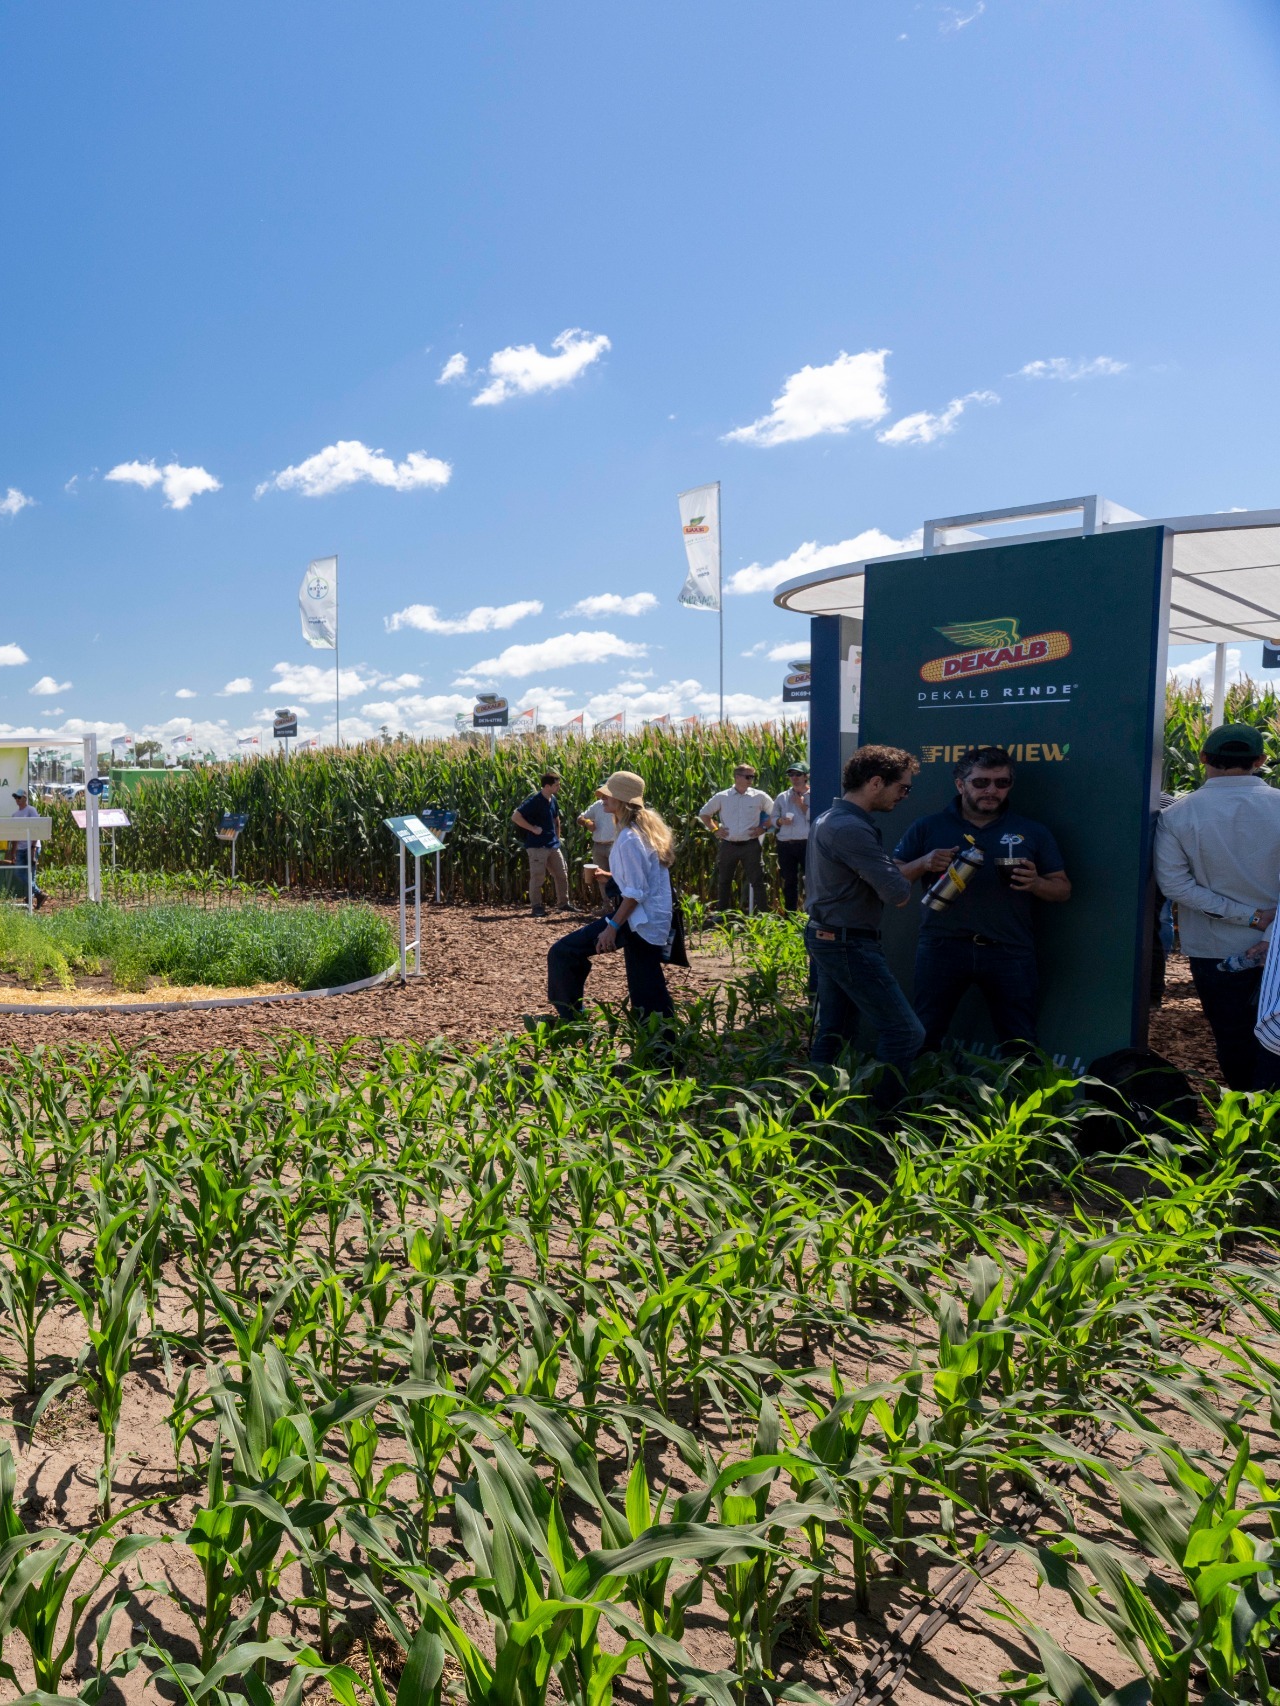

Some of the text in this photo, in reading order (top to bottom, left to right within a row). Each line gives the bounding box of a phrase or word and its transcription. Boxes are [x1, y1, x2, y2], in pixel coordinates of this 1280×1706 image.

[942, 640, 1048, 679] DEKALB
[918, 689, 989, 701] DEKALB
[921, 743, 1065, 763] FIEVIEW
